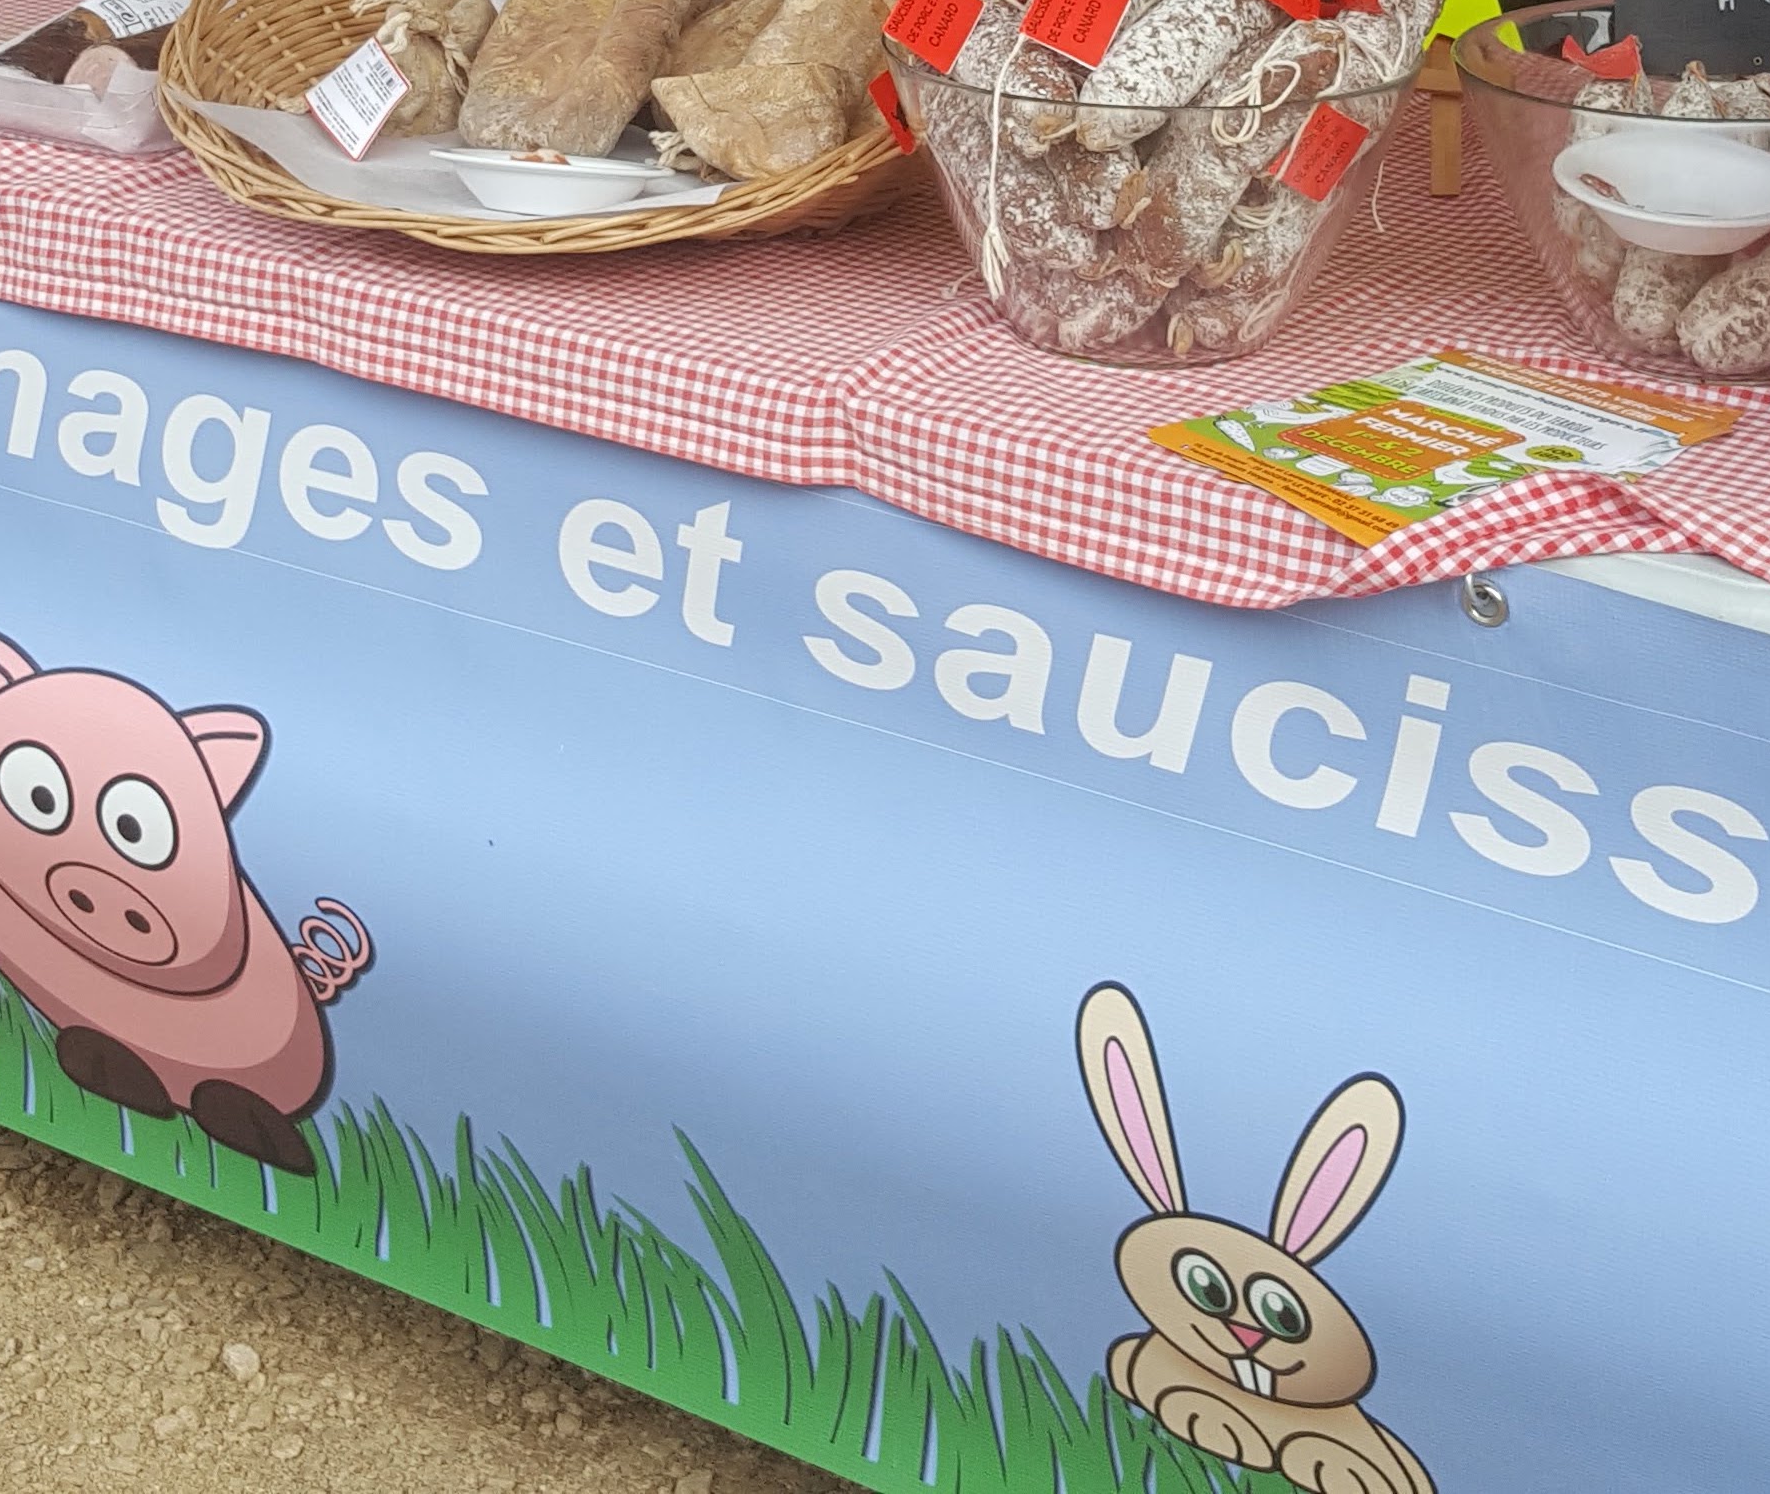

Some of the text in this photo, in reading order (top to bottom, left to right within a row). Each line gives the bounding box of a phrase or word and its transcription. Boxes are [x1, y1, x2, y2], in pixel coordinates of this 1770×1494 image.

[906, 28, 918, 44] DE
[914, 5, 932, 33] PORC
[929, 2, 959, 48] CANARD
[1046, 29, 1058, 44] DE
[1055, 7, 1071, 33] PORC
[1315, 141, 1350, 184] CANARD
[1547, 385, 1569, 399] LE
[1354, 416, 1471, 456] FERMIER
[1382, 407, 1504, 448] MARCHÉ
[1395, 446, 1424, 457] 2
[558, 498, 746, 650] et
